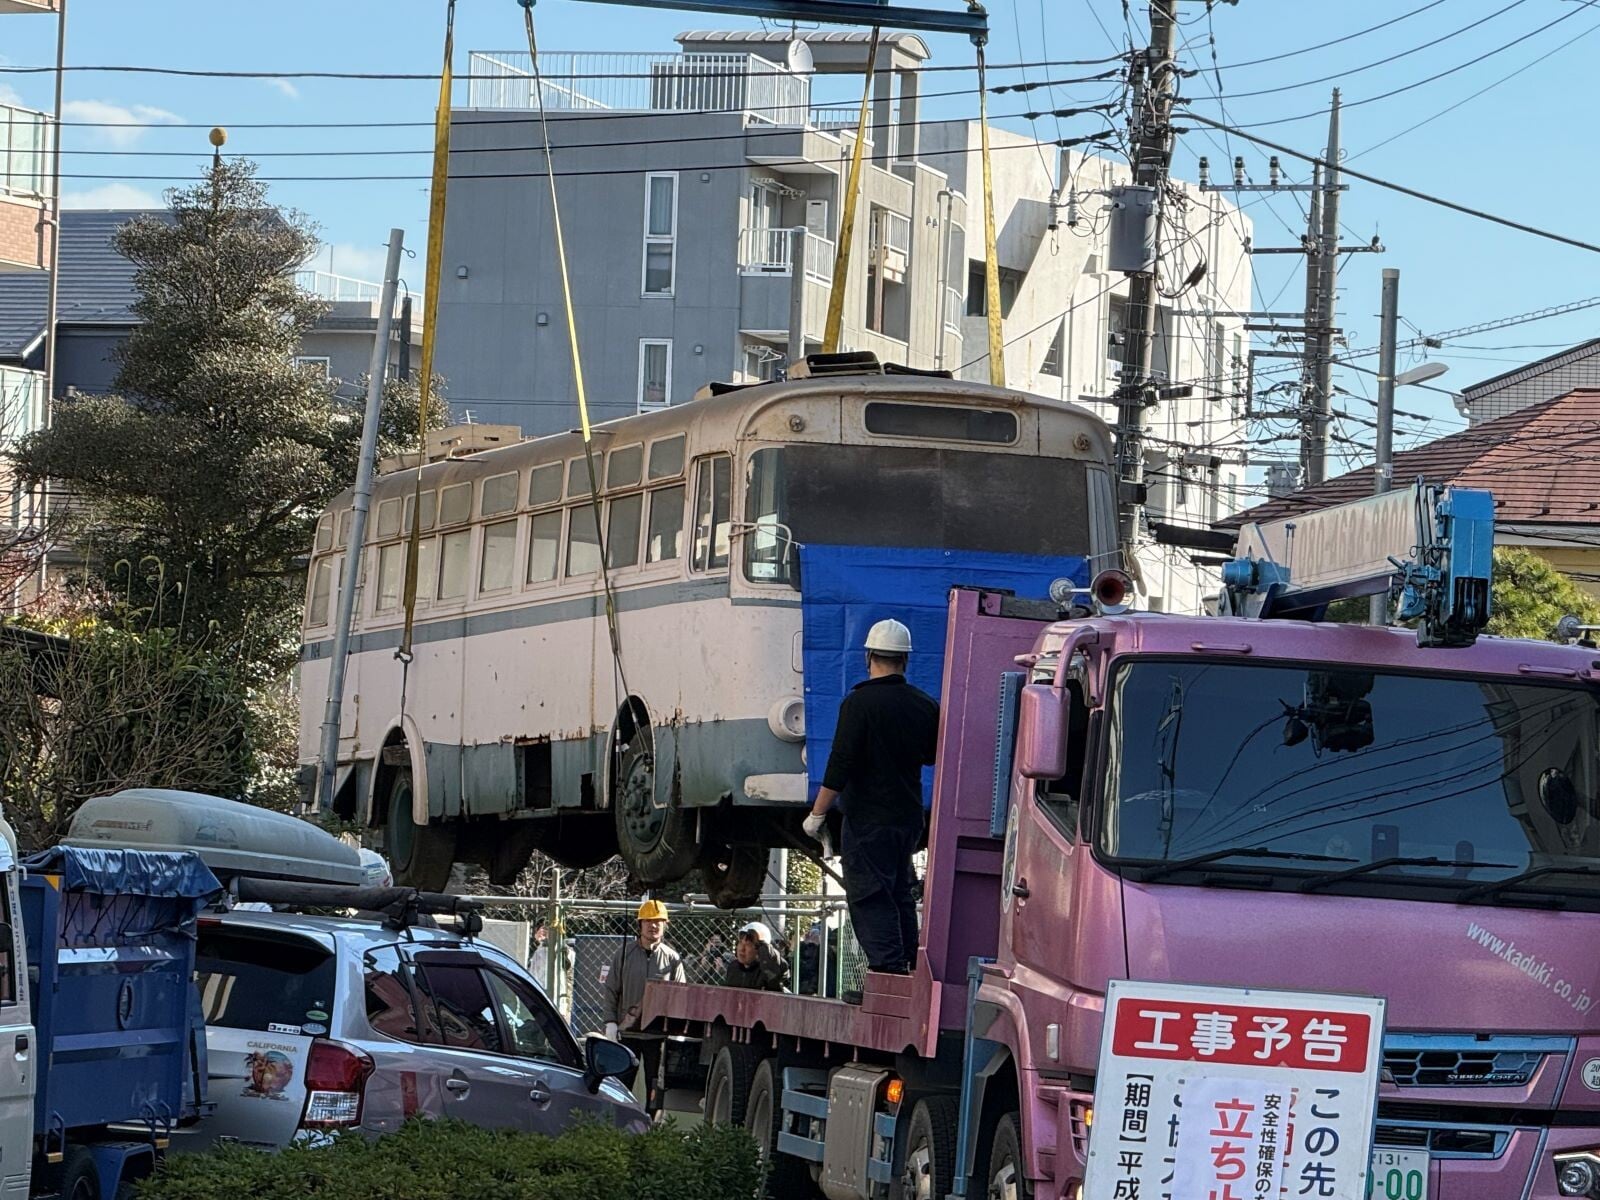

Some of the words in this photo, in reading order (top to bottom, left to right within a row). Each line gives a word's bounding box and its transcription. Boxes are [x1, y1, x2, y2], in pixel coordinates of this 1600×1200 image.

[247, 1041, 297, 1053] CALIFORNIA
[1133, 1009, 1348, 1063] 工事予告
[1298, 1088, 1340, 1197] この先
[1369, 1168, 1423, 1200] -00
